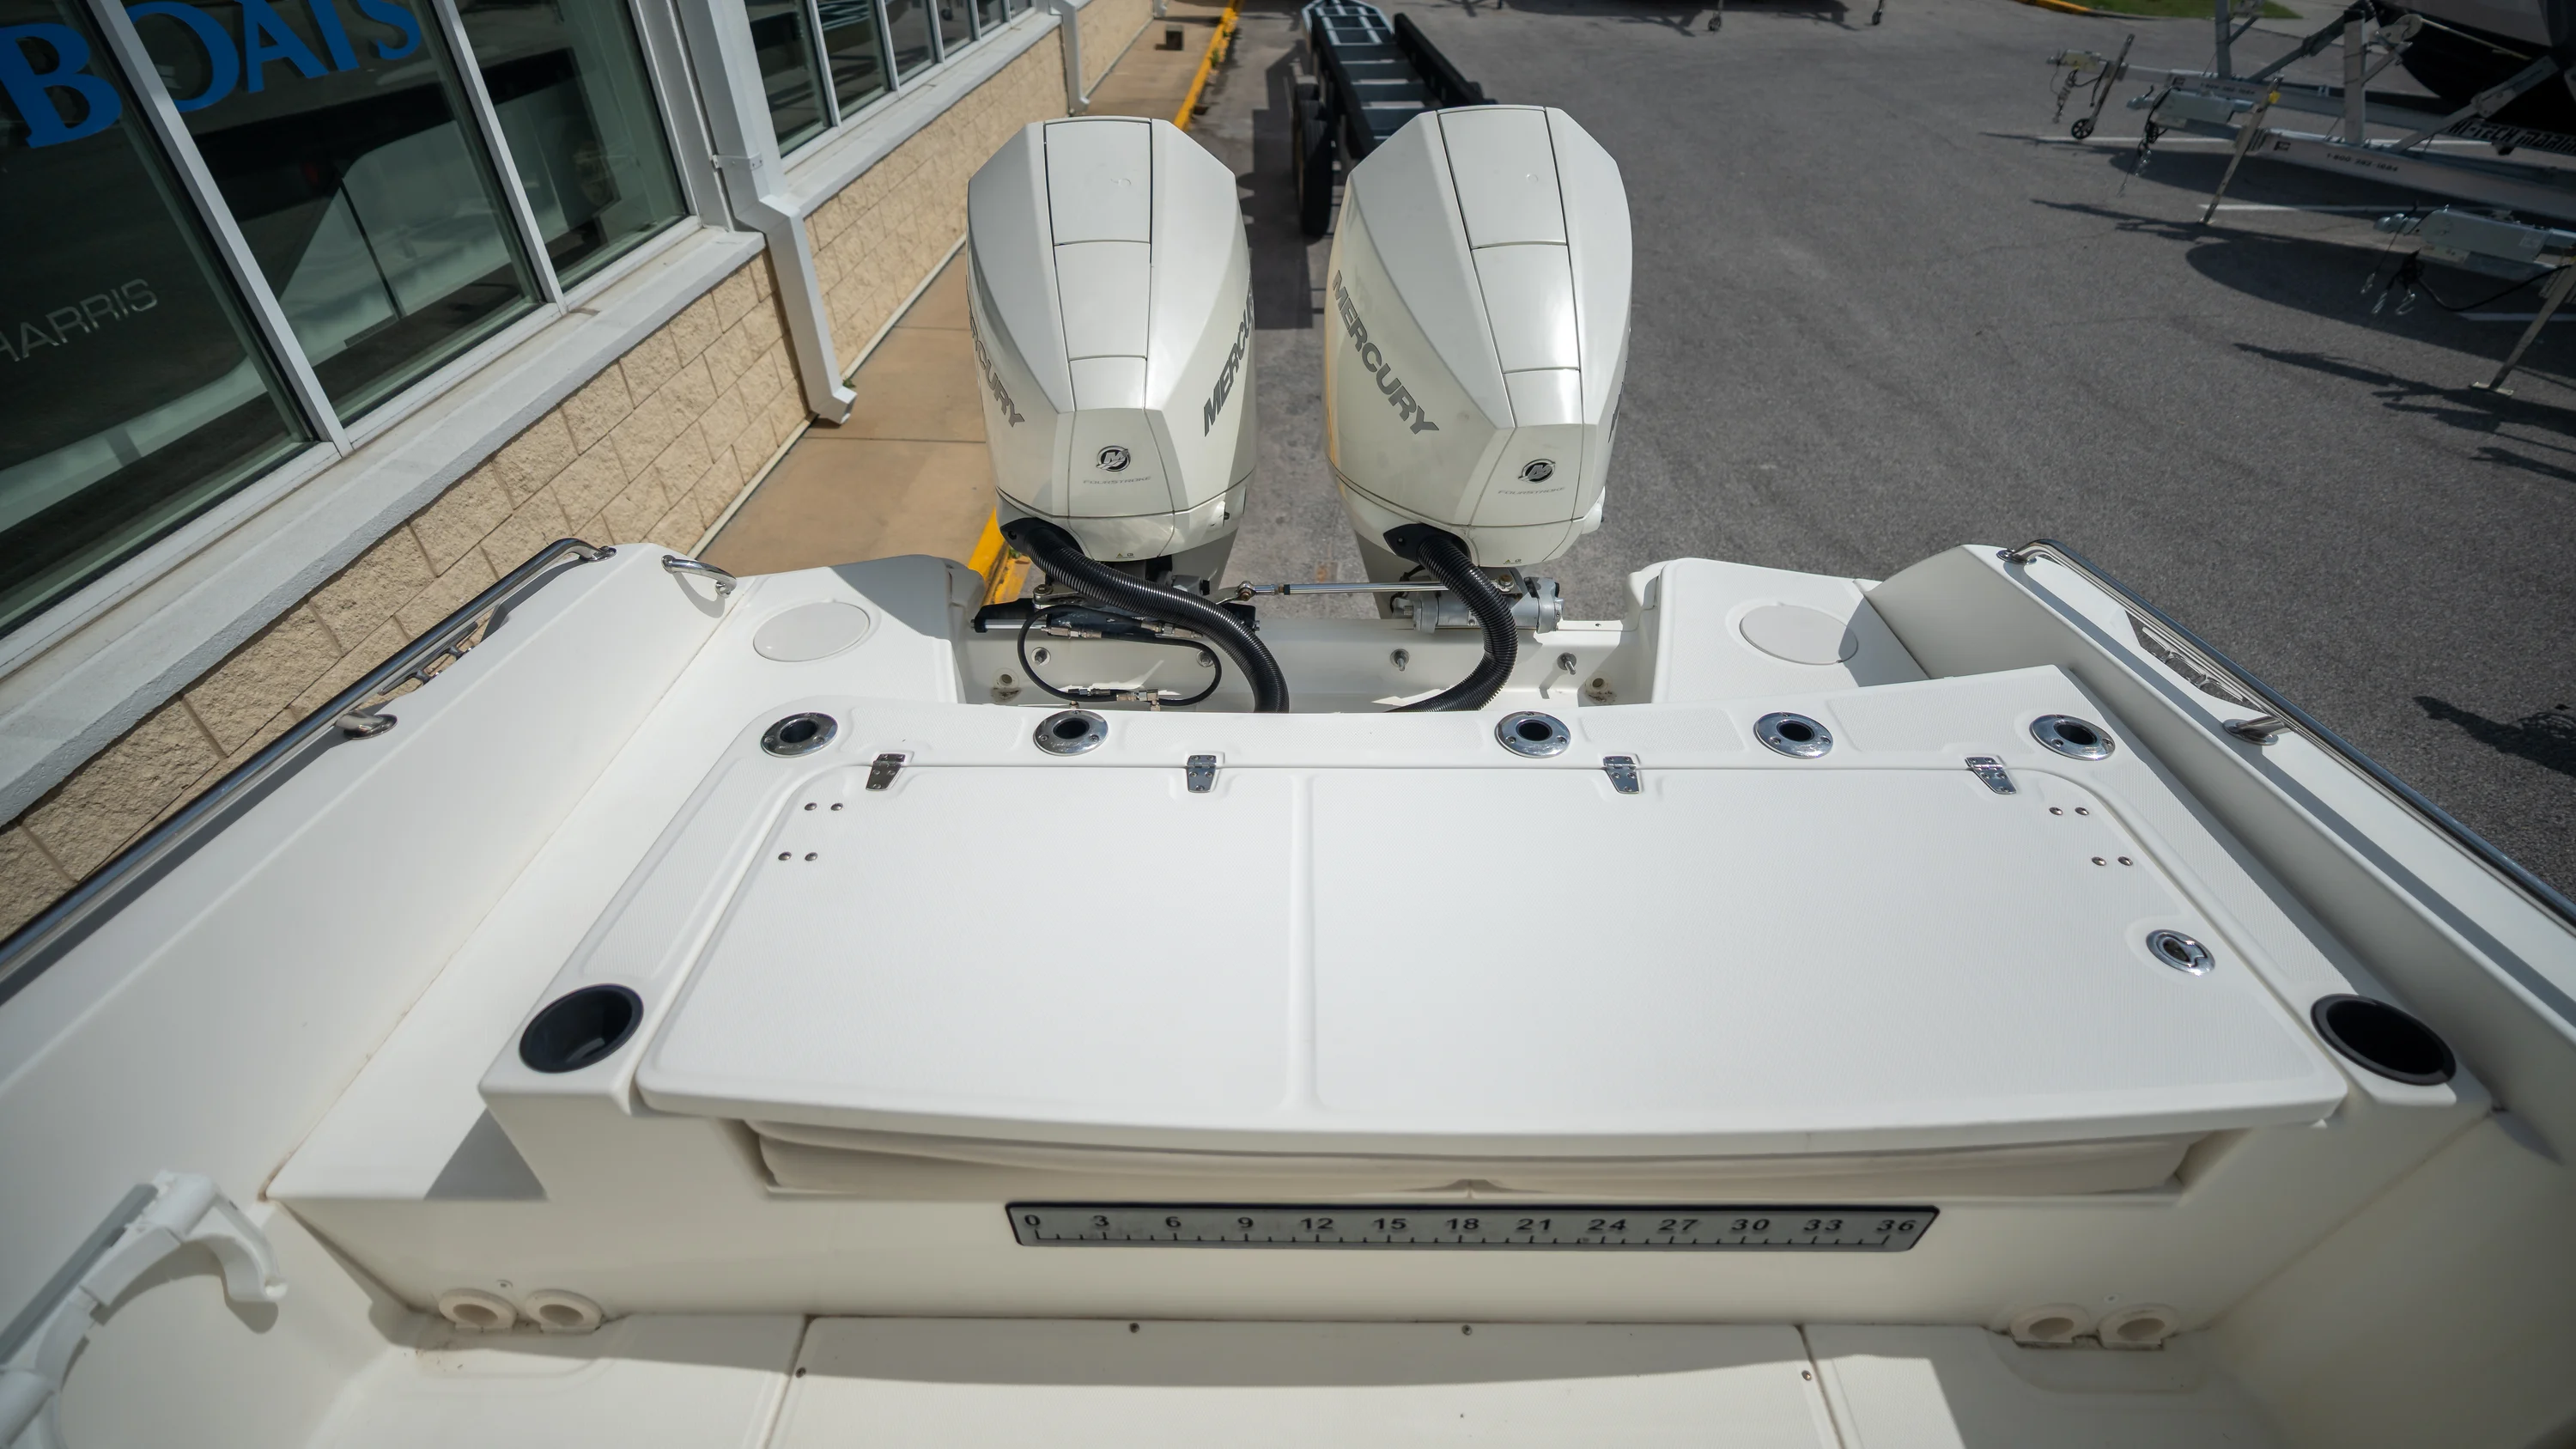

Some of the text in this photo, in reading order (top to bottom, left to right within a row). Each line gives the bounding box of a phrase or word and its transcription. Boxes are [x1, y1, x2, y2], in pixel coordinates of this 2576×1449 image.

[1332, 270, 1440, 435] MERCURY
[1024, 1215, 1916, 1233] 0 3 6 9 12 15 18 21 24 27 30 33 36
